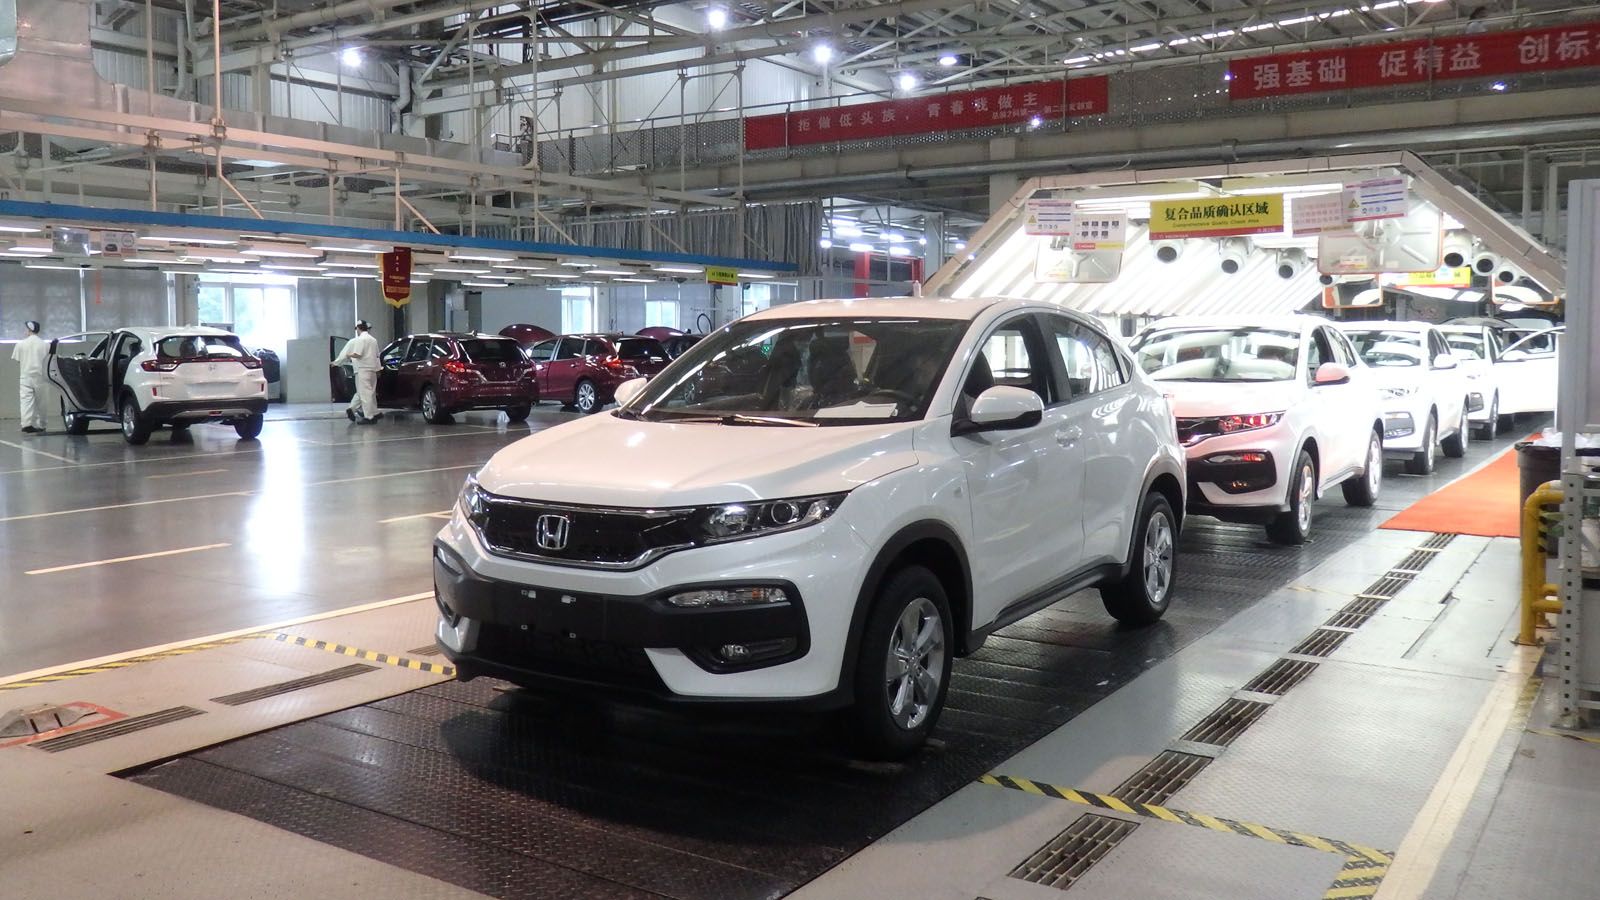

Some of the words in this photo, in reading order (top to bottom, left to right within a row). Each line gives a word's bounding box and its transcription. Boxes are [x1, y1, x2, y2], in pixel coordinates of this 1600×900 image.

[1253, 56, 1347, 90] 强基础
[1379, 42, 1481, 77] 促精益
[1518, 31, 1600, 64] 创标
[1165, 201, 1269, 221] 复合品质确认区域
